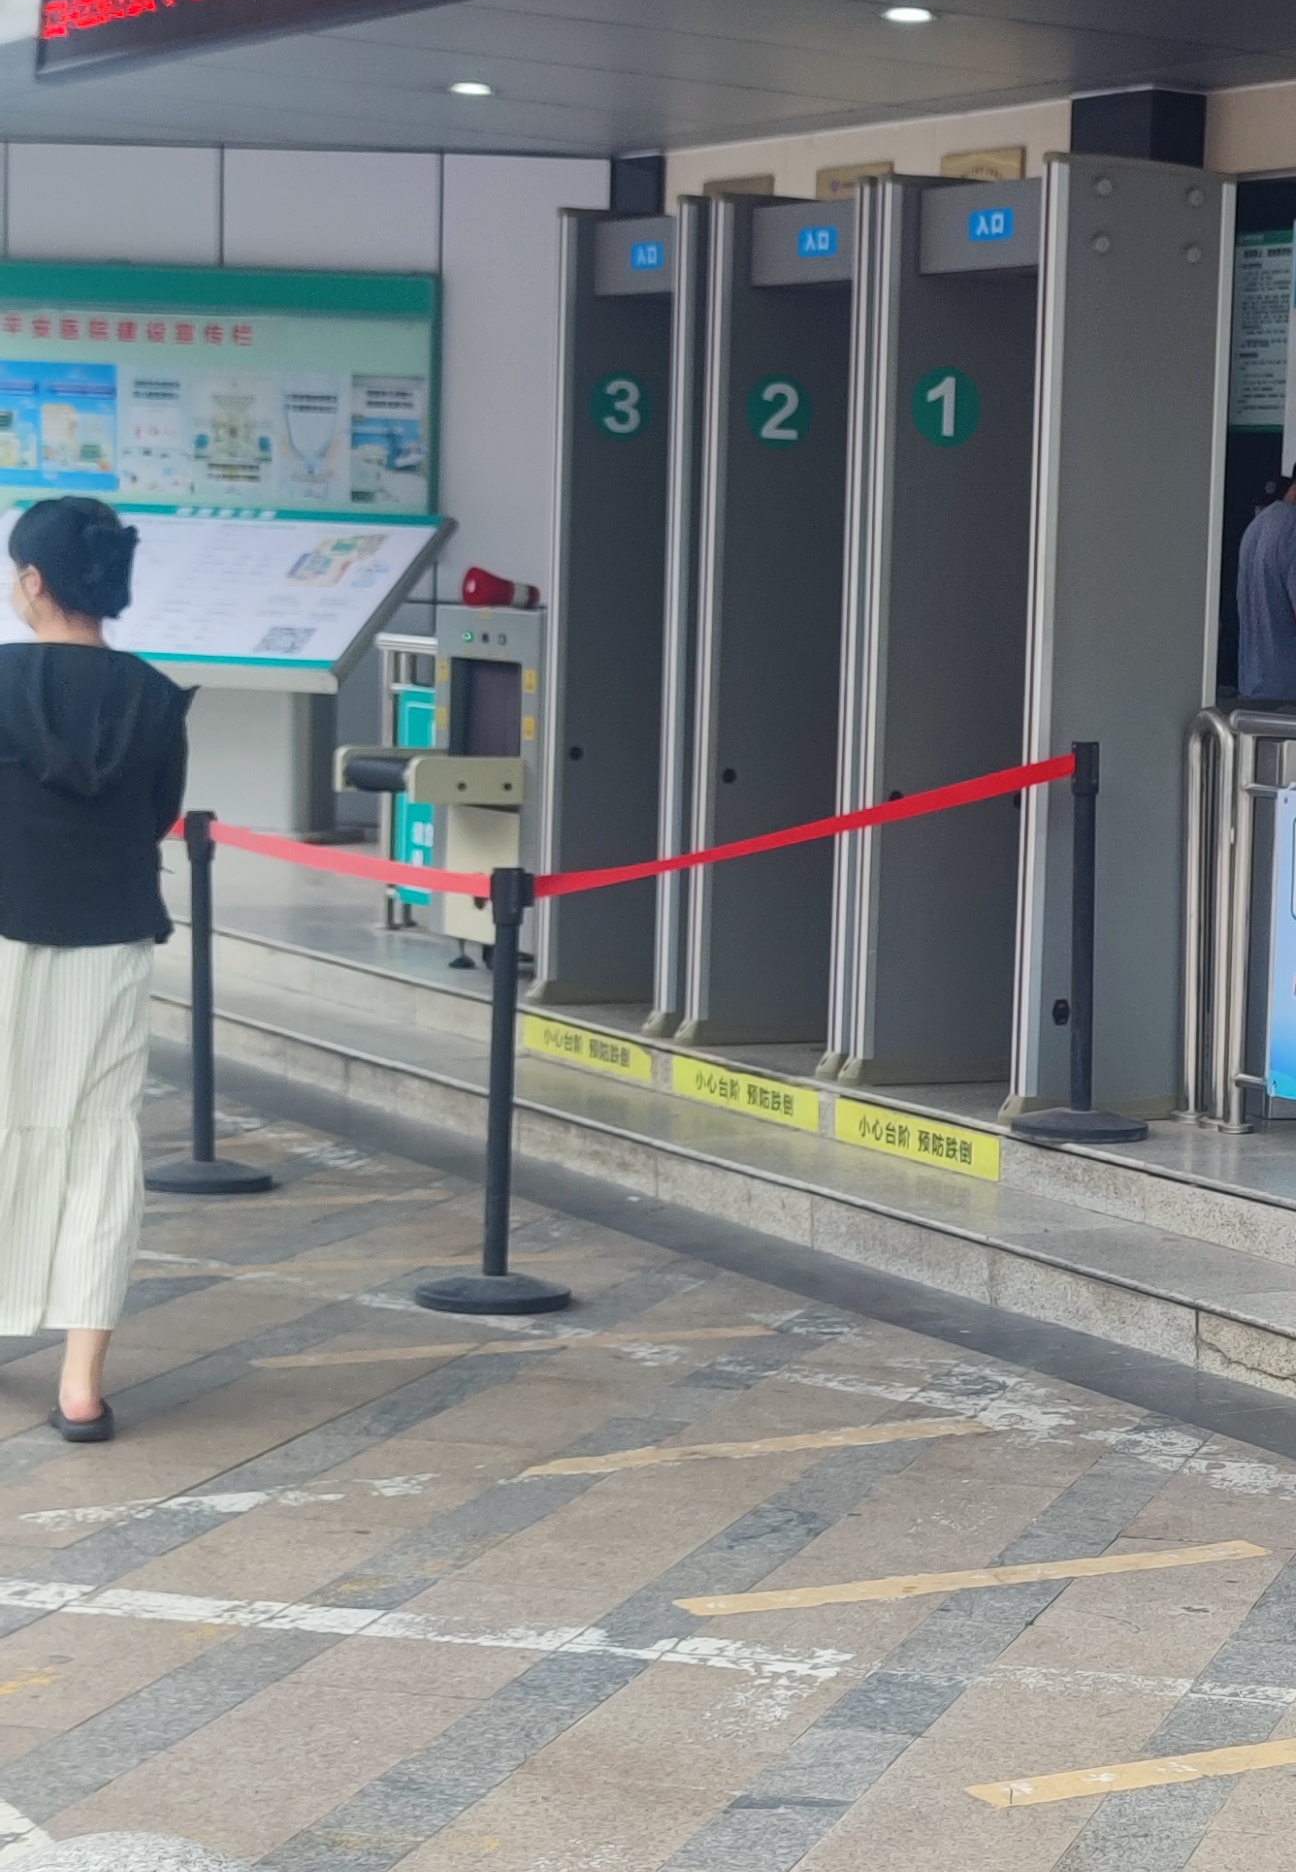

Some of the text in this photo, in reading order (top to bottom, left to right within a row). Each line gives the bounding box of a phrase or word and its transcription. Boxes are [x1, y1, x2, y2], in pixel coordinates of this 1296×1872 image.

[975, 214, 1005, 237] 入口
[604, 380, 641, 433] 3
[760, 384, 799, 441] 2
[925, 376, 958, 437] 1
[543, 1028, 583, 1055] 小心台阶
[695, 1070, 795, 1118] 小心台阶 预防跌倒
[858, 1114, 973, 1166] 小心台阶 预防跌倒
